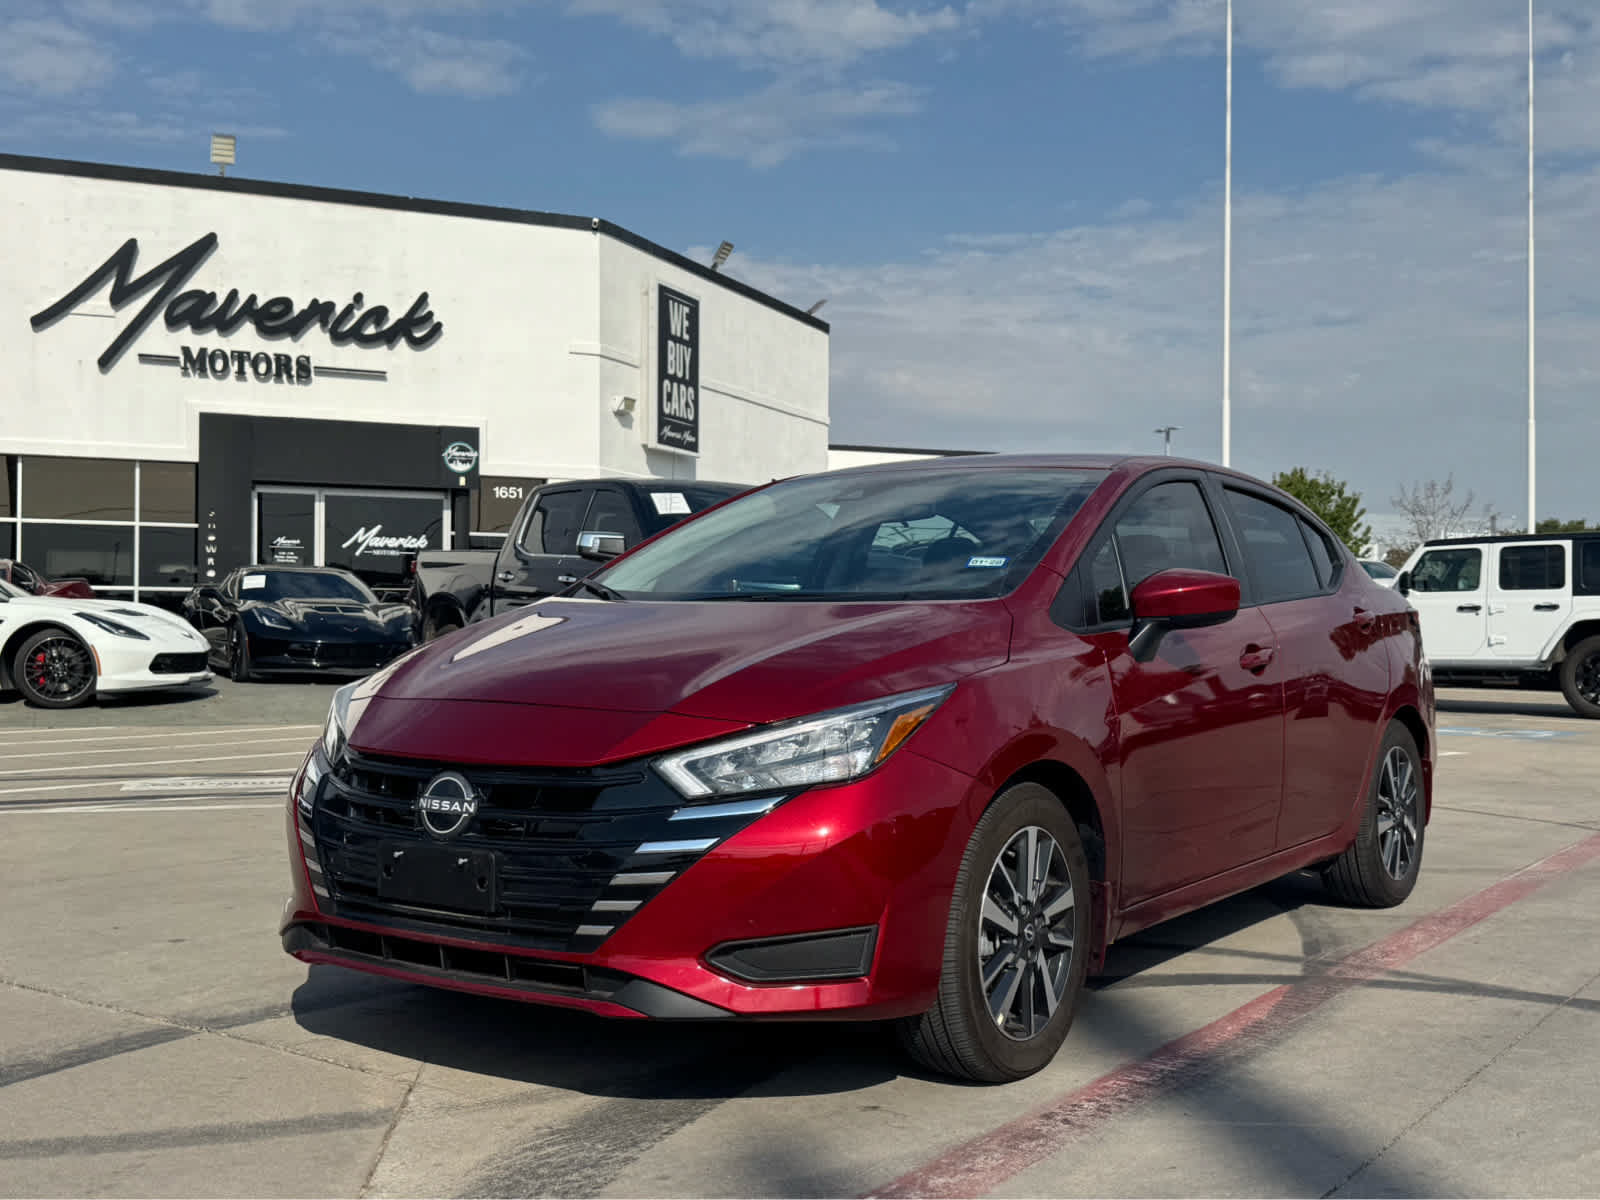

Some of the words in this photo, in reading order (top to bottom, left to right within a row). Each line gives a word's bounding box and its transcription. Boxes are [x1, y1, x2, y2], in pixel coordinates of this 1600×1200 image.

[30, 232, 443, 373] Maverick
[668, 300, 690, 341] WE
[180, 346, 313, 382] MOTORS
[667, 340, 692, 380] BUY
[662, 379, 695, 421] CARS
[492, 486, 524, 499] 1651
[342, 524, 428, 556] Maverick
[419, 798, 475, 813] NISSAN
